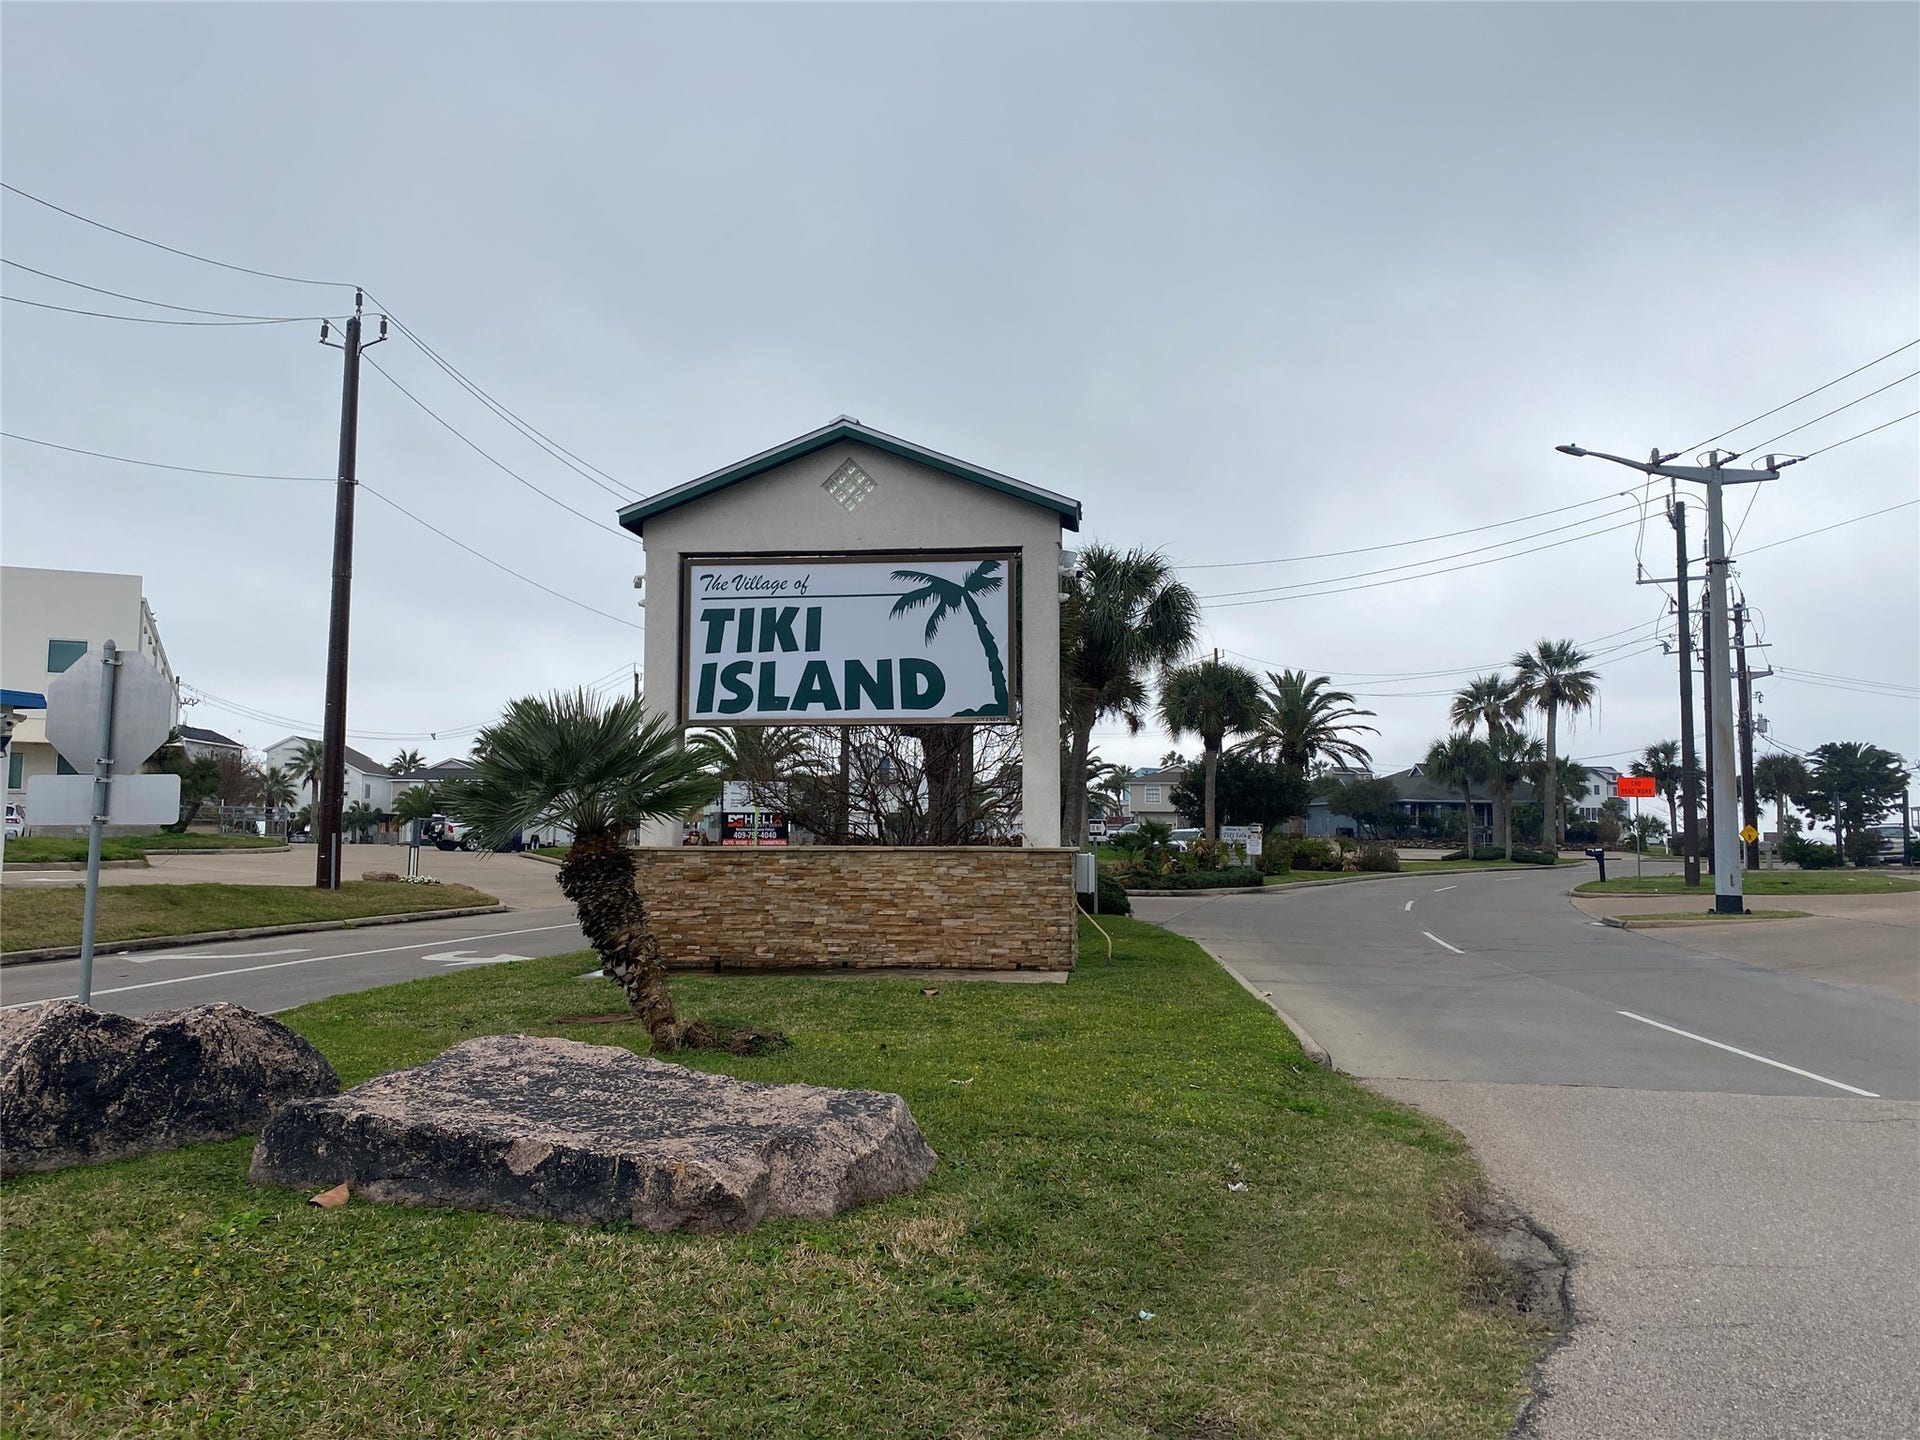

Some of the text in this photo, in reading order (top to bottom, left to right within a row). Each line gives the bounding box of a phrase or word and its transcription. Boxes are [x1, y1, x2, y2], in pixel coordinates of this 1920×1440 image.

[700, 574, 810, 595] The Village of
[700, 606, 822, 654] TIKI
[696, 657, 946, 714] ISLAND
